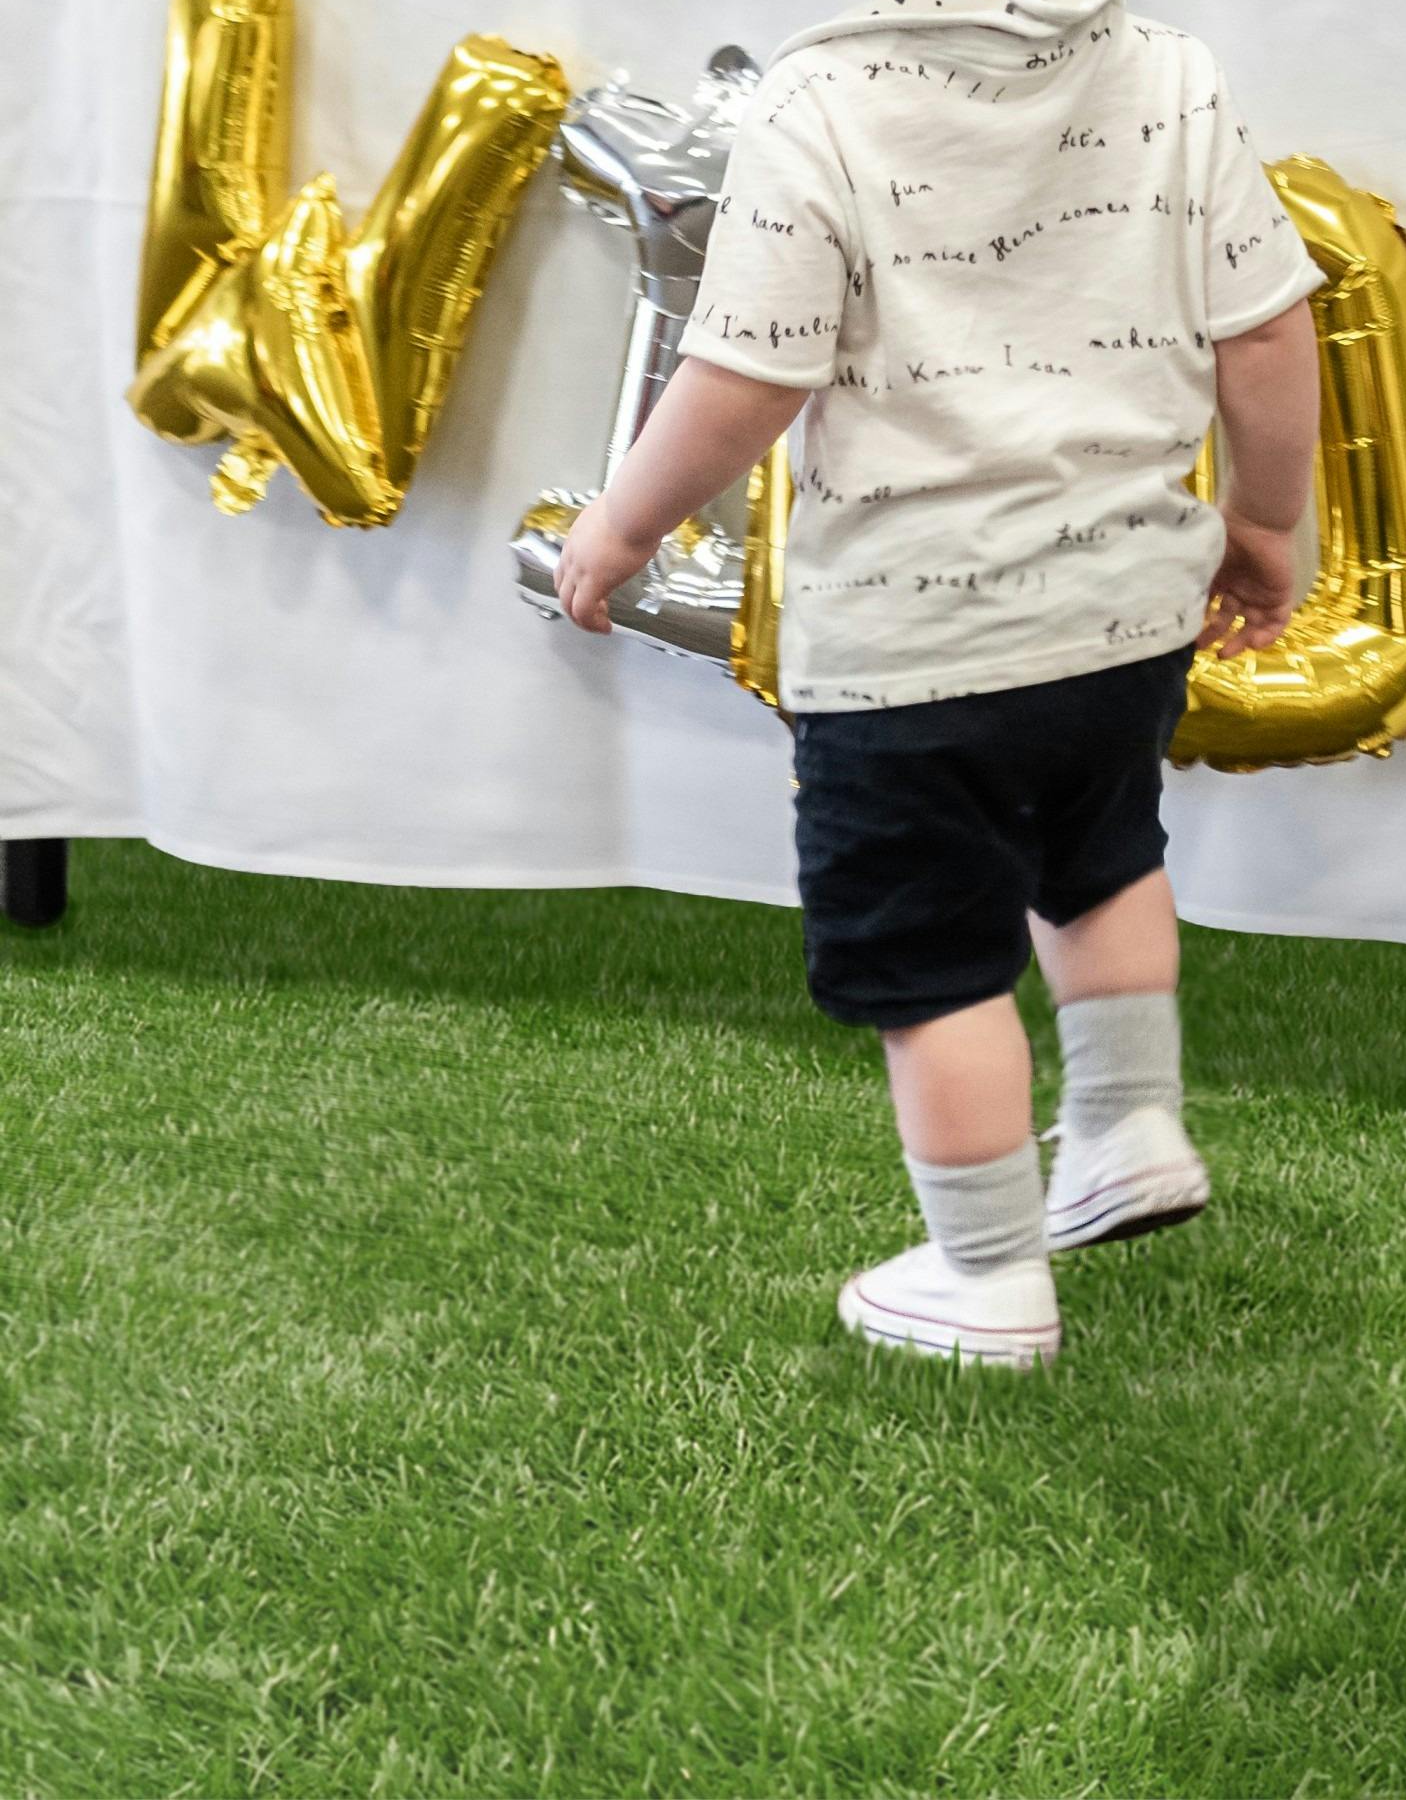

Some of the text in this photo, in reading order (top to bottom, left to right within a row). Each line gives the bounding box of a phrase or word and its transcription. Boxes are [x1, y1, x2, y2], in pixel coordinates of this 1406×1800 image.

[862, 60, 930, 80] yeah
[1058, 125, 1107, 152] Let's
[1141, 121, 1166, 143] go
[889, 179, 934, 207] fun
[752, 208, 796, 237] have
[921, 245, 979, 265] nice
[1058, 201, 1132, 223] comes
[720, 314, 757, 341] I'm
[1003, 344, 1014, 368] I
[1028, 360, 1074, 378] can
